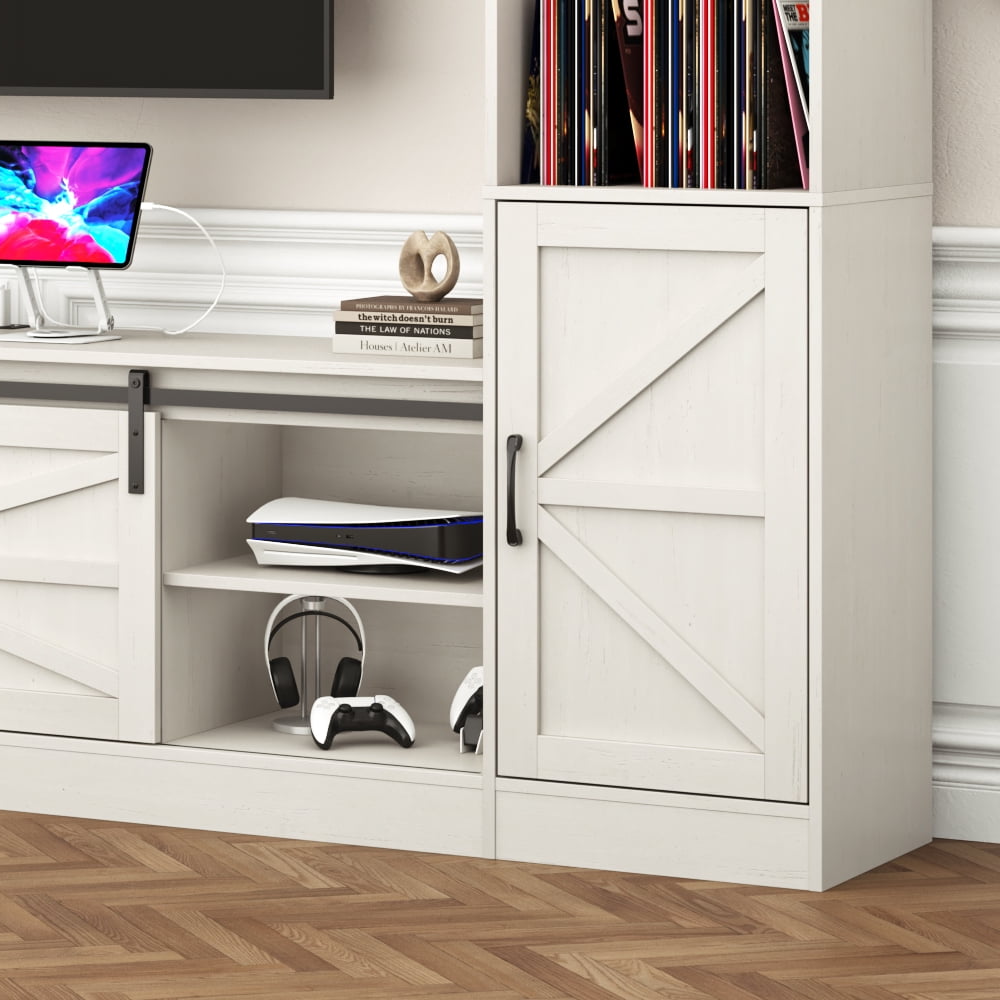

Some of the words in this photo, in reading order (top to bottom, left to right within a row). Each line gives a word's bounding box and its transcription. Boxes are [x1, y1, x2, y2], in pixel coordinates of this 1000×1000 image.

[358, 313, 372, 321] the
[373, 313, 397, 322] witch
[399, 314, 431, 323] doesn't
[432, 315, 454, 324] burn
[360, 325, 376, 333] THE
[414, 327, 451, 335] NATIONS
[360, 340, 393, 351] Houses
[400, 340, 431, 353] Atelier
[433, 343, 452, 353] AM
